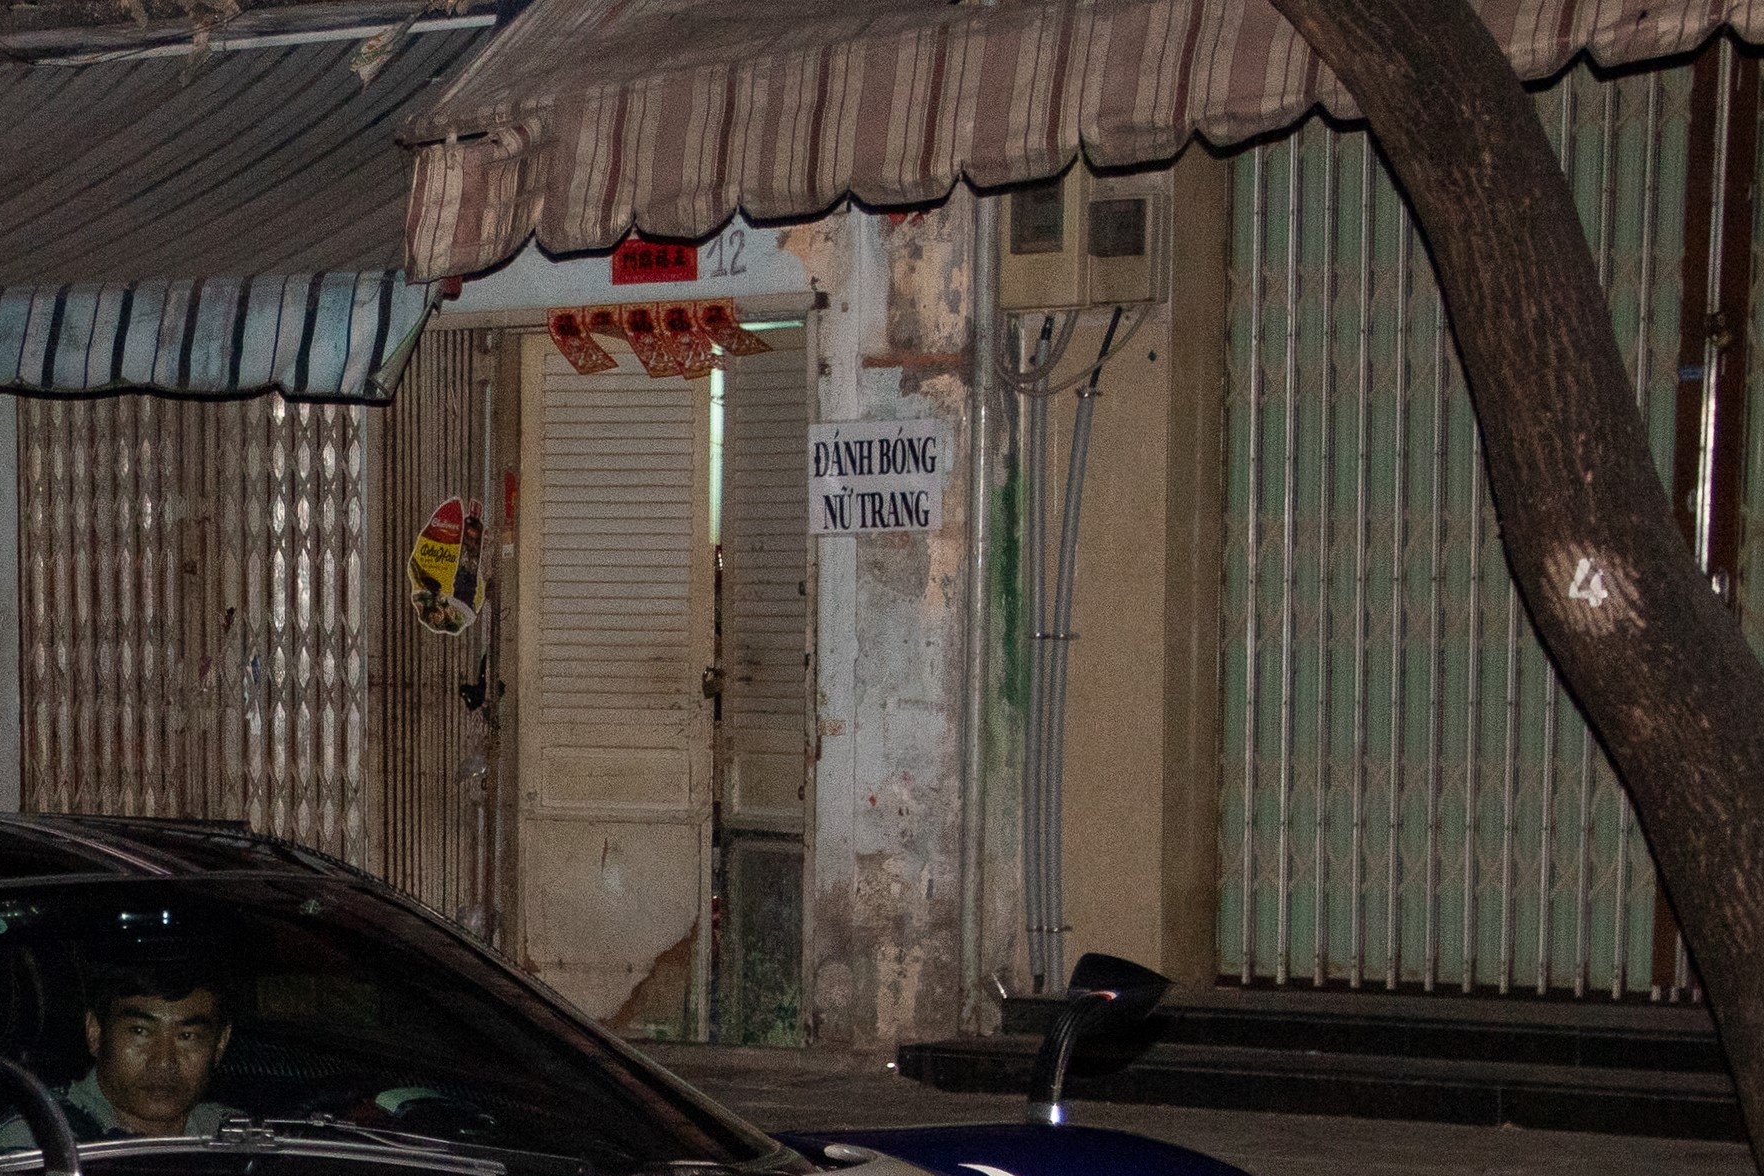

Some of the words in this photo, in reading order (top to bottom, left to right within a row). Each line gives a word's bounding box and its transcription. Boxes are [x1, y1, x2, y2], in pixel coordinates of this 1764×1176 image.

[706, 229, 747, 277] 12
[814, 429, 874, 478] ĐÁNH
[879, 426, 937, 475] BÓNG
[824, 486, 854, 530] NỮ
[857, 490, 931, 529] TRANG
[1568, 558, 1608, 608] 4
